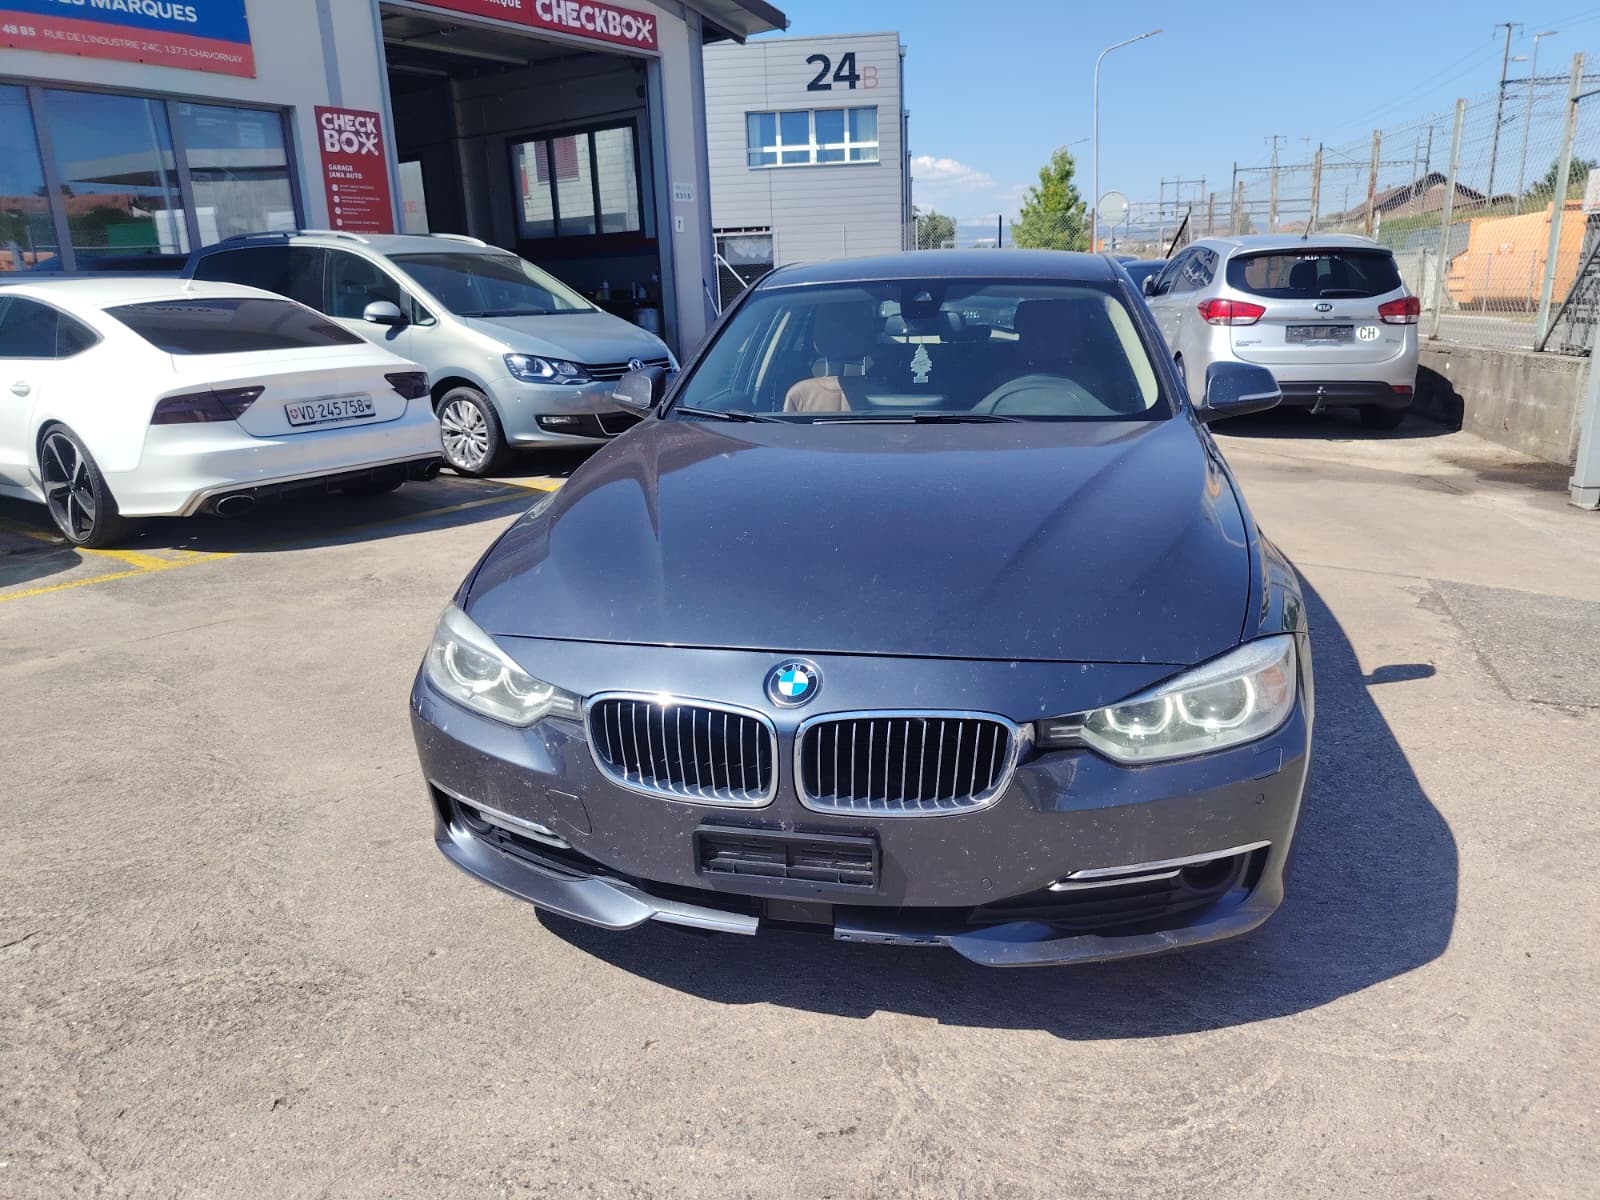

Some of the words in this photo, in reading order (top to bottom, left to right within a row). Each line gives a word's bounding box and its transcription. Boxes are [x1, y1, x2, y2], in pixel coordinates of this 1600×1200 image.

[2, 24, 18, 34] 48
[43, 29, 65, 40] RUE
[67, 32, 81, 42] DE
[83, 35, 139, 49] L'INDUSTRIE
[189, 49, 242, 63] CHAVORNAY
[321, 113, 377, 133] CHECK
[323, 130, 379, 156] BOX
[1317, 304, 1331, 312] KIA
[1359, 327, 1376, 340] CH
